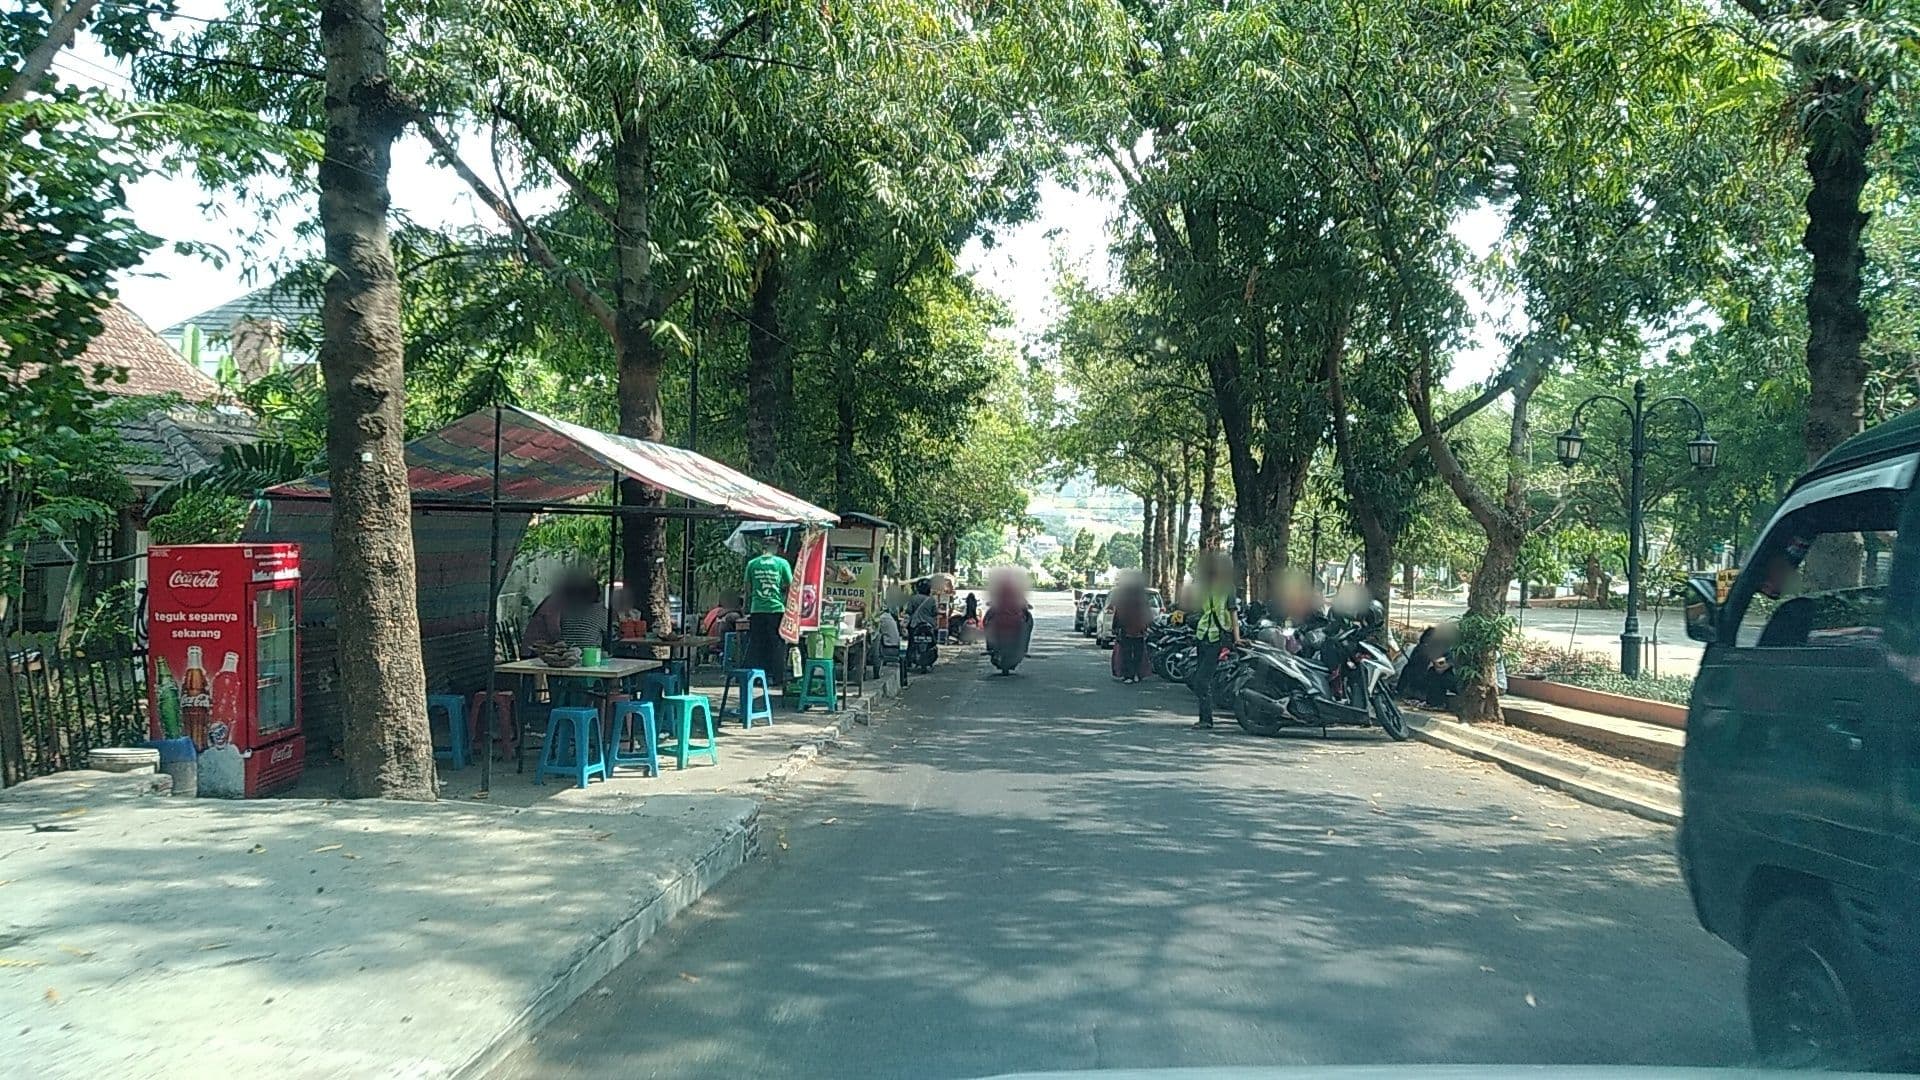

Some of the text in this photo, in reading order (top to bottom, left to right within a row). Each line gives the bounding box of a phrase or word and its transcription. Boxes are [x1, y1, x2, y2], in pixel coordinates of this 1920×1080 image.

[168, 569, 221, 588] Coca-Cola
[826, 586, 866, 598] BATAGOR
[155, 611, 238, 623] teguk segarnya
[171, 628, 221, 640] sekarang
